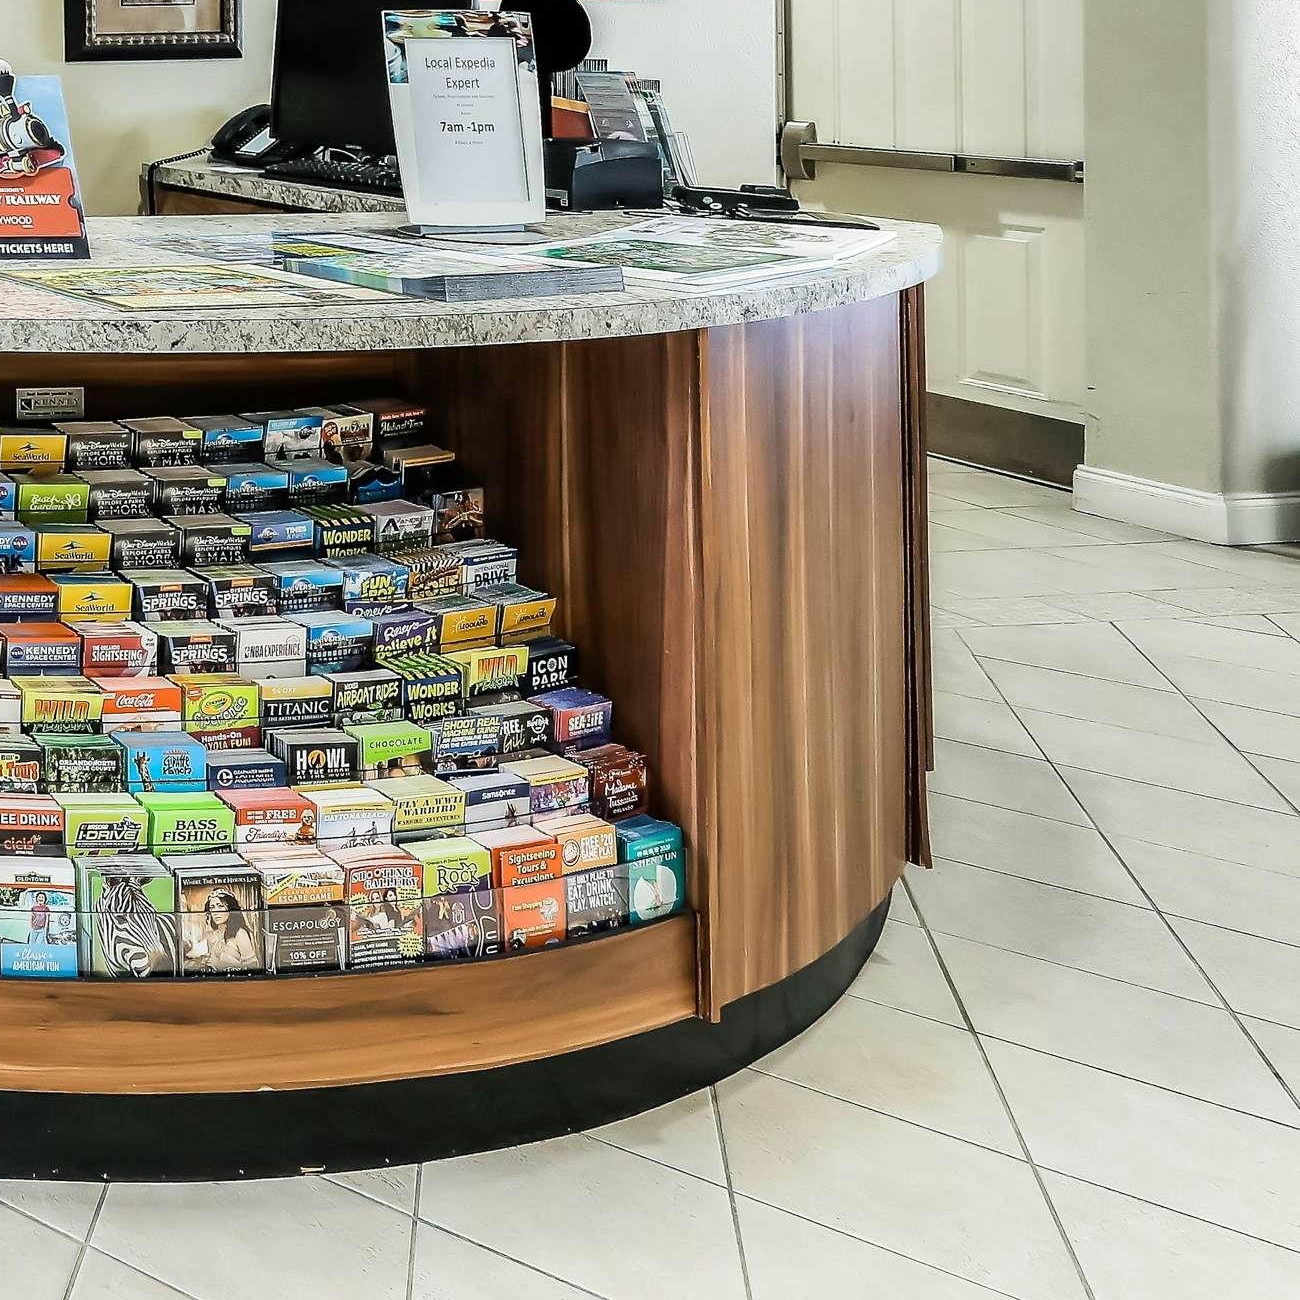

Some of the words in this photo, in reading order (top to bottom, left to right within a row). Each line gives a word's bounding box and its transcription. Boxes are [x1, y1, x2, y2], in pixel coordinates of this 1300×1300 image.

[425, 57, 452, 70] Local
[455, 57, 495, 71] Expedia
[445, 76, 480, 91] Expert
[440, 122, 464, 132] 7am
[5, 194, 61, 205] RAILWAY
[0, 244, 41, 253] TICKETS
[44, 243, 74, 253] HERE!
[143, 596, 197, 611] SPRINGS
[92, 650, 143, 662] SIGHTSEEING
[532, 656, 568, 674] ICON
[532, 671, 568, 687] PARK
[337, 688, 374, 707] AIRBOAT
[376, 682, 399, 698] RIDES
[408, 683, 458, 698] WONDER
[34, 699, 90, 721] WILD
[267, 701, 329, 715] TITANIC
[411, 702, 456, 719] WORKS
[444, 719, 475, 731] SHOOT
[477, 717, 501, 727] REAL
[201, 732, 242, 743] Hands-On
[369, 738, 423, 749] CHOCOLATE
[7, 760, 39, 781] Tours
[604, 782, 637, 796] Madame
[266, 810, 296, 820] FREE
[404, 804, 457, 817] WARBIRD
[20, 813, 59, 825] DRINK
[176, 820, 218, 830] BASS
[162, 831, 228, 842] FISHING
[508, 849, 556, 865] Sightseeing
[517, 864, 539, 874] Tours
[540, 862, 547, 870] &
[289, 951, 307, 960] 10%
[310, 950, 326, 958] OFF
